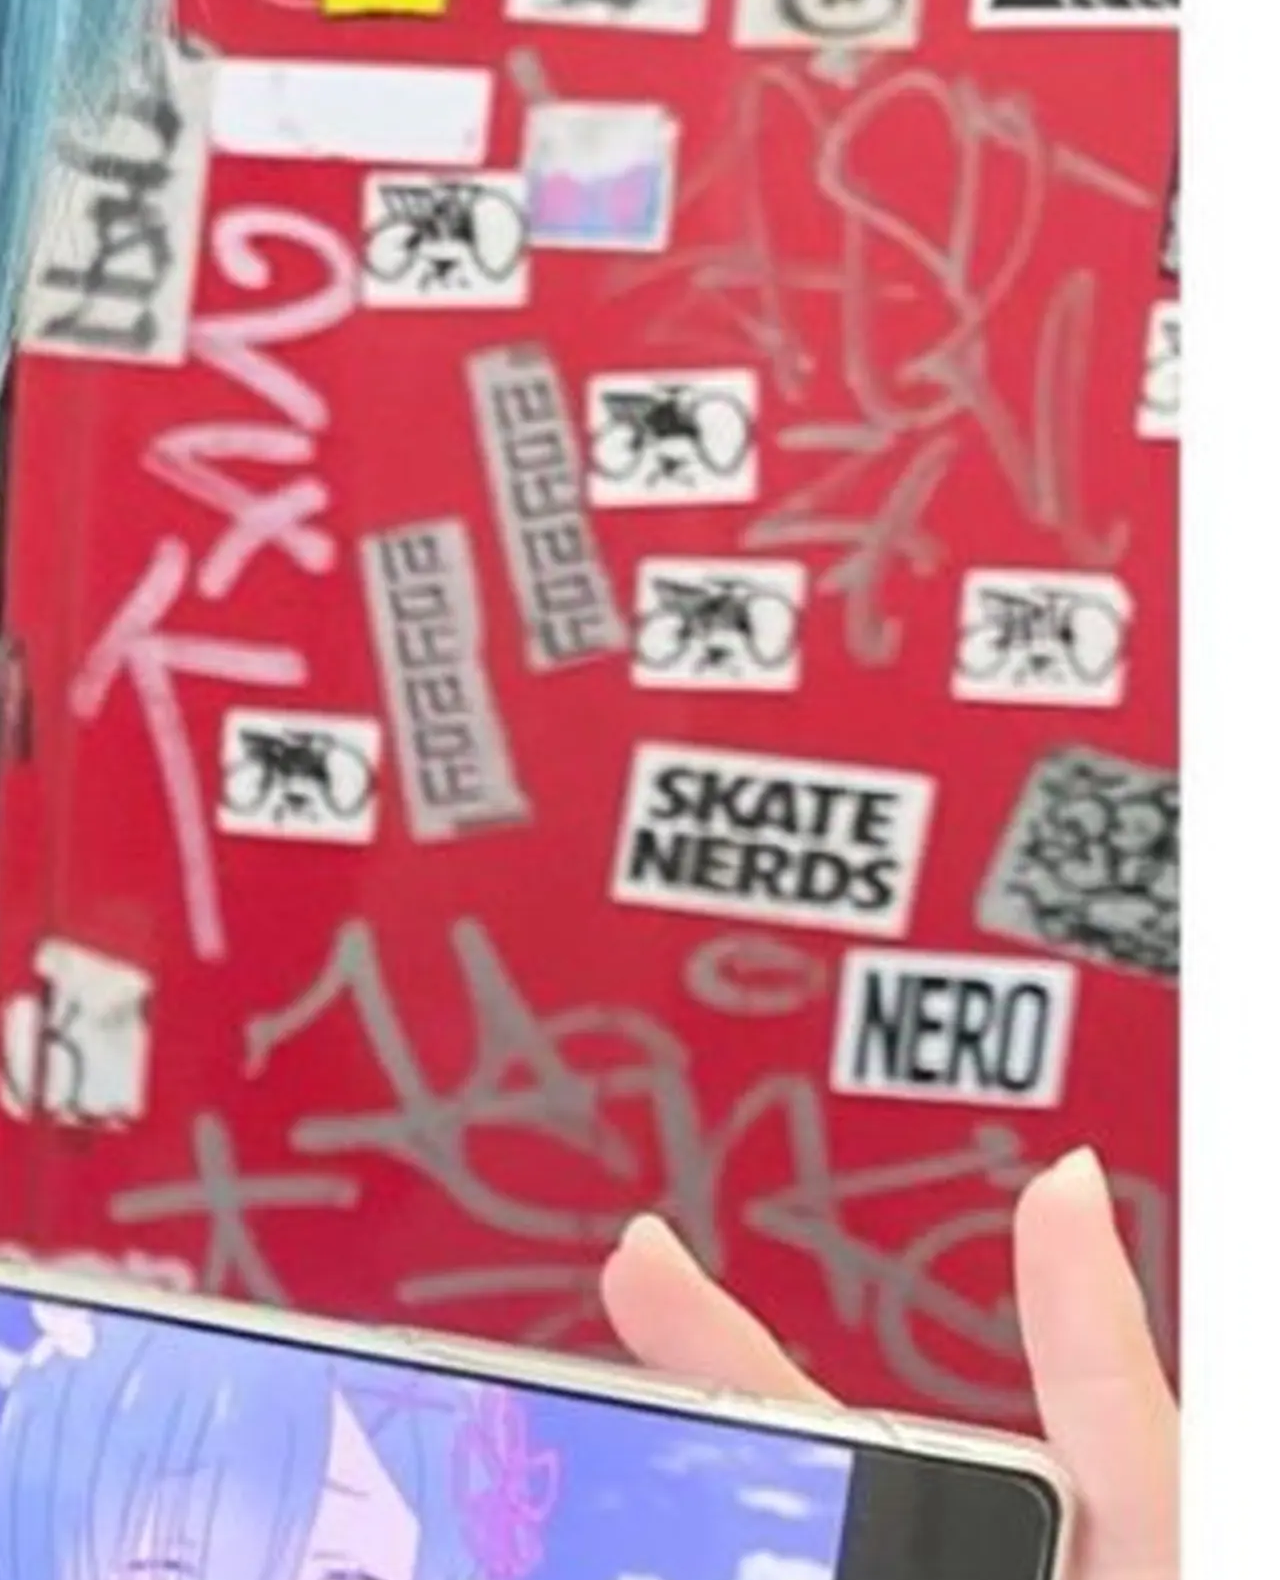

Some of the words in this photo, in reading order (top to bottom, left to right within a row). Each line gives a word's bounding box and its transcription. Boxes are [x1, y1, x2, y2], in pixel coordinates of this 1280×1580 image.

[649, 765, 901, 849] SKATE
[628, 831, 901, 910] NERDS
[852, 968, 1052, 1093] NERO
